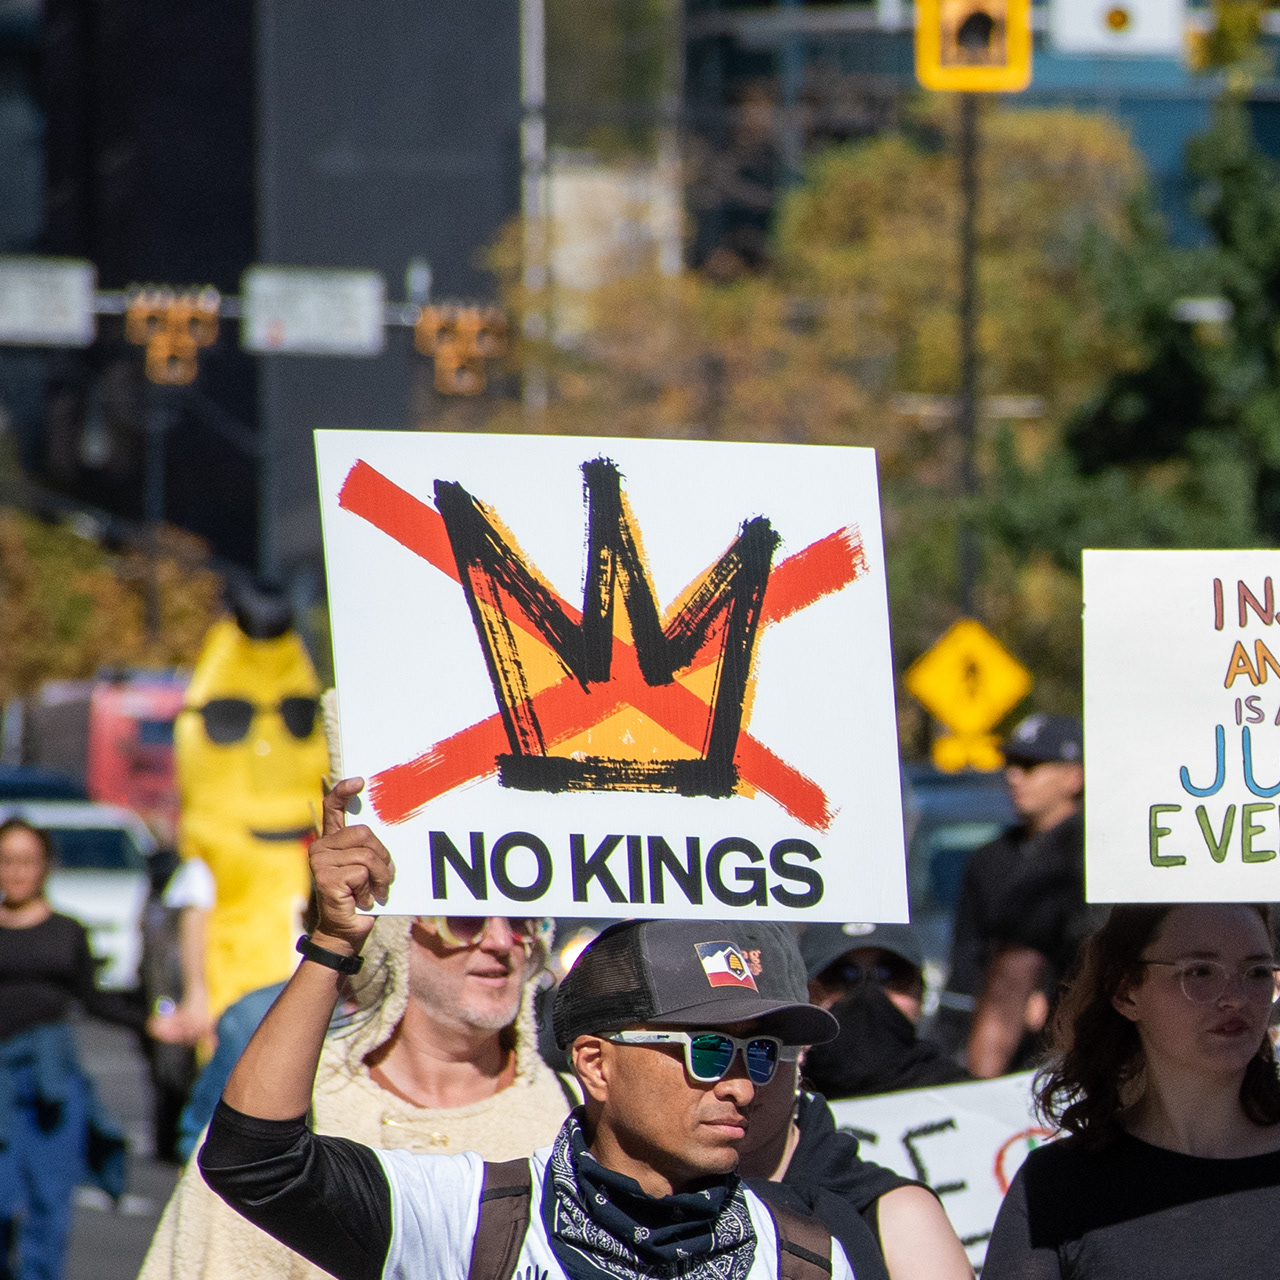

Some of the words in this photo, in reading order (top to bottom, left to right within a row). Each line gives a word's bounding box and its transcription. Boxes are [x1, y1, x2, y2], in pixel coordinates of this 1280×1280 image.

[1234, 695, 1265, 726] IS
[429, 830, 553, 902] NO
[569, 833, 825, 909] KINGS
